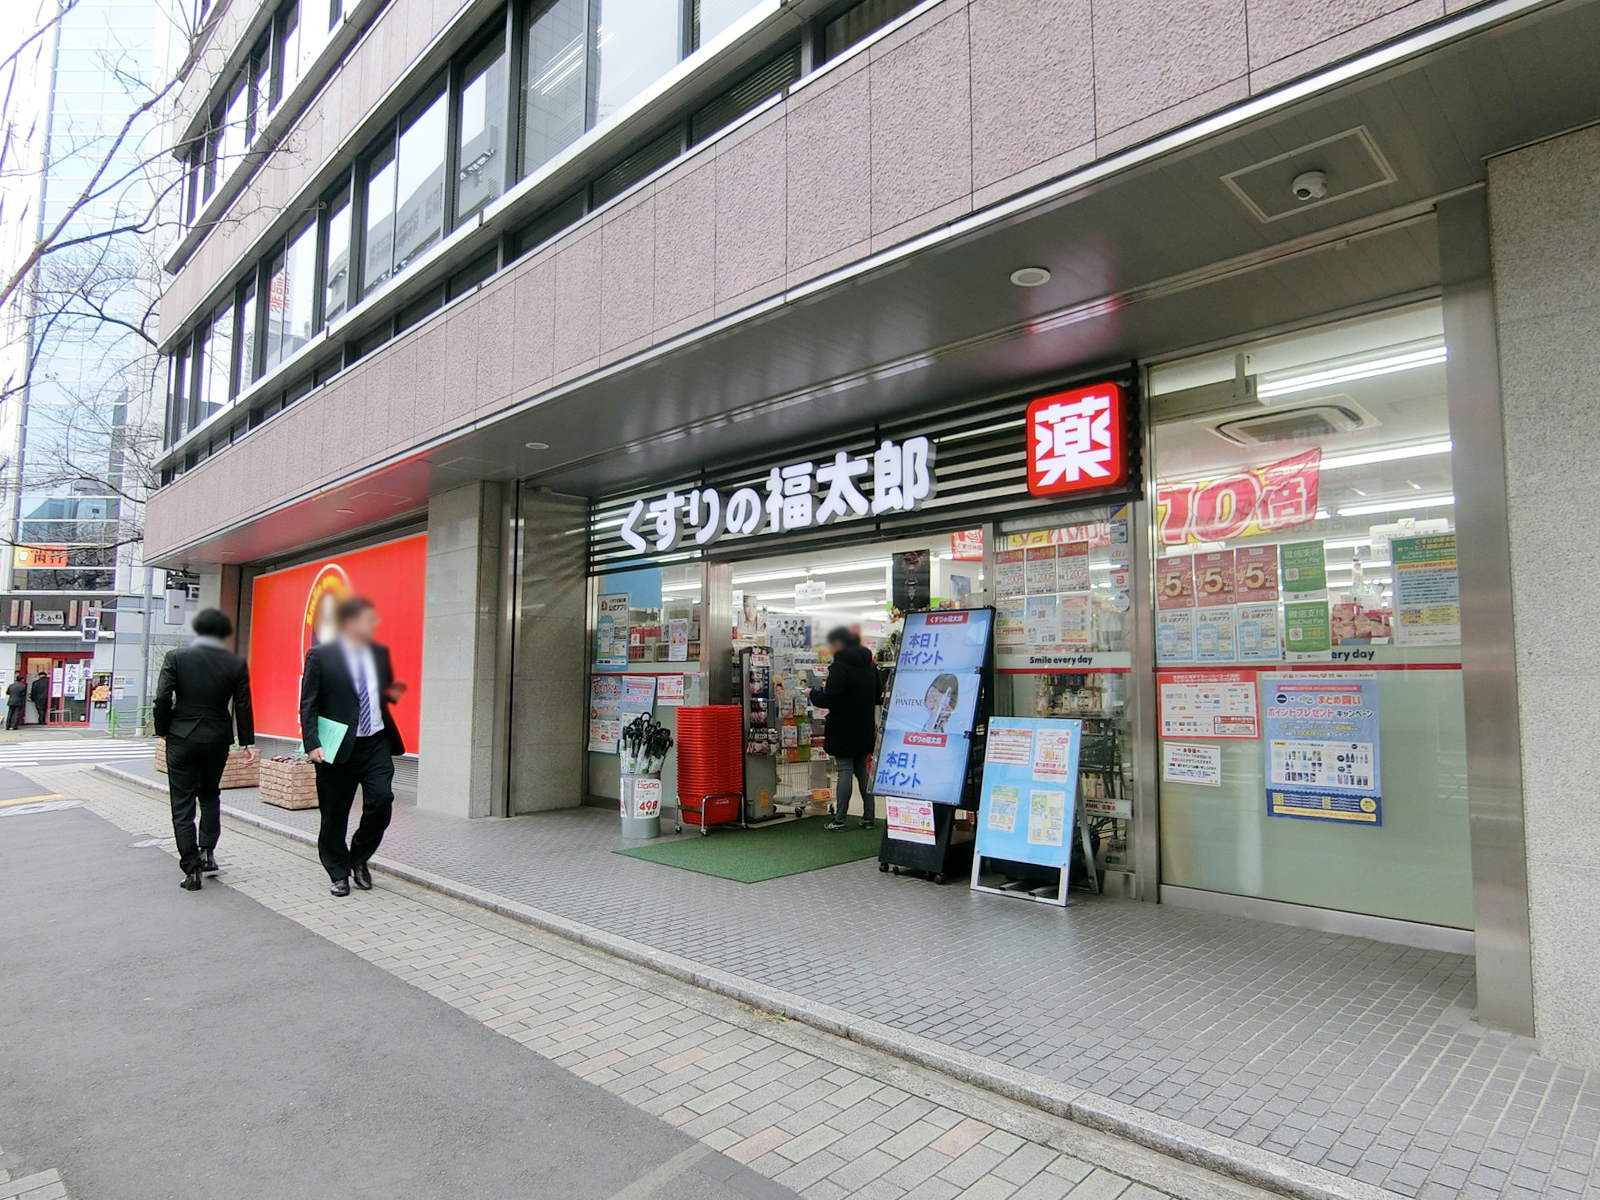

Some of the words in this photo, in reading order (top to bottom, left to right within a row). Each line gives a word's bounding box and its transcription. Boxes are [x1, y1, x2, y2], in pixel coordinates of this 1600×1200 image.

[1035, 396, 1111, 487] 薬
[621, 436, 931, 552] くすりの福太郎
[1157, 474, 1306, 544] 10倍
[1288, 609, 1325, 618] 微信支付
[1289, 618, 1312, 626] WeChat
[900, 650, 943, 665] ポイント
[1029, 655, 1052, 664] Smile
[1053, 657, 1076, 665] every
[1077, 655, 1093, 665] day
[1352, 649, 1375, 661] day
[67, 664, 77, 693] たかね
[895, 698, 923, 707] PANTENE
[1317, 695, 1362, 705] まとめ買い
[1268, 708, 1335, 718] ポイントプレゼント
[1337, 710, 1374, 718] キャンペーン
[877, 769, 921, 788] ポイント
[639, 800, 658, 811] 498
